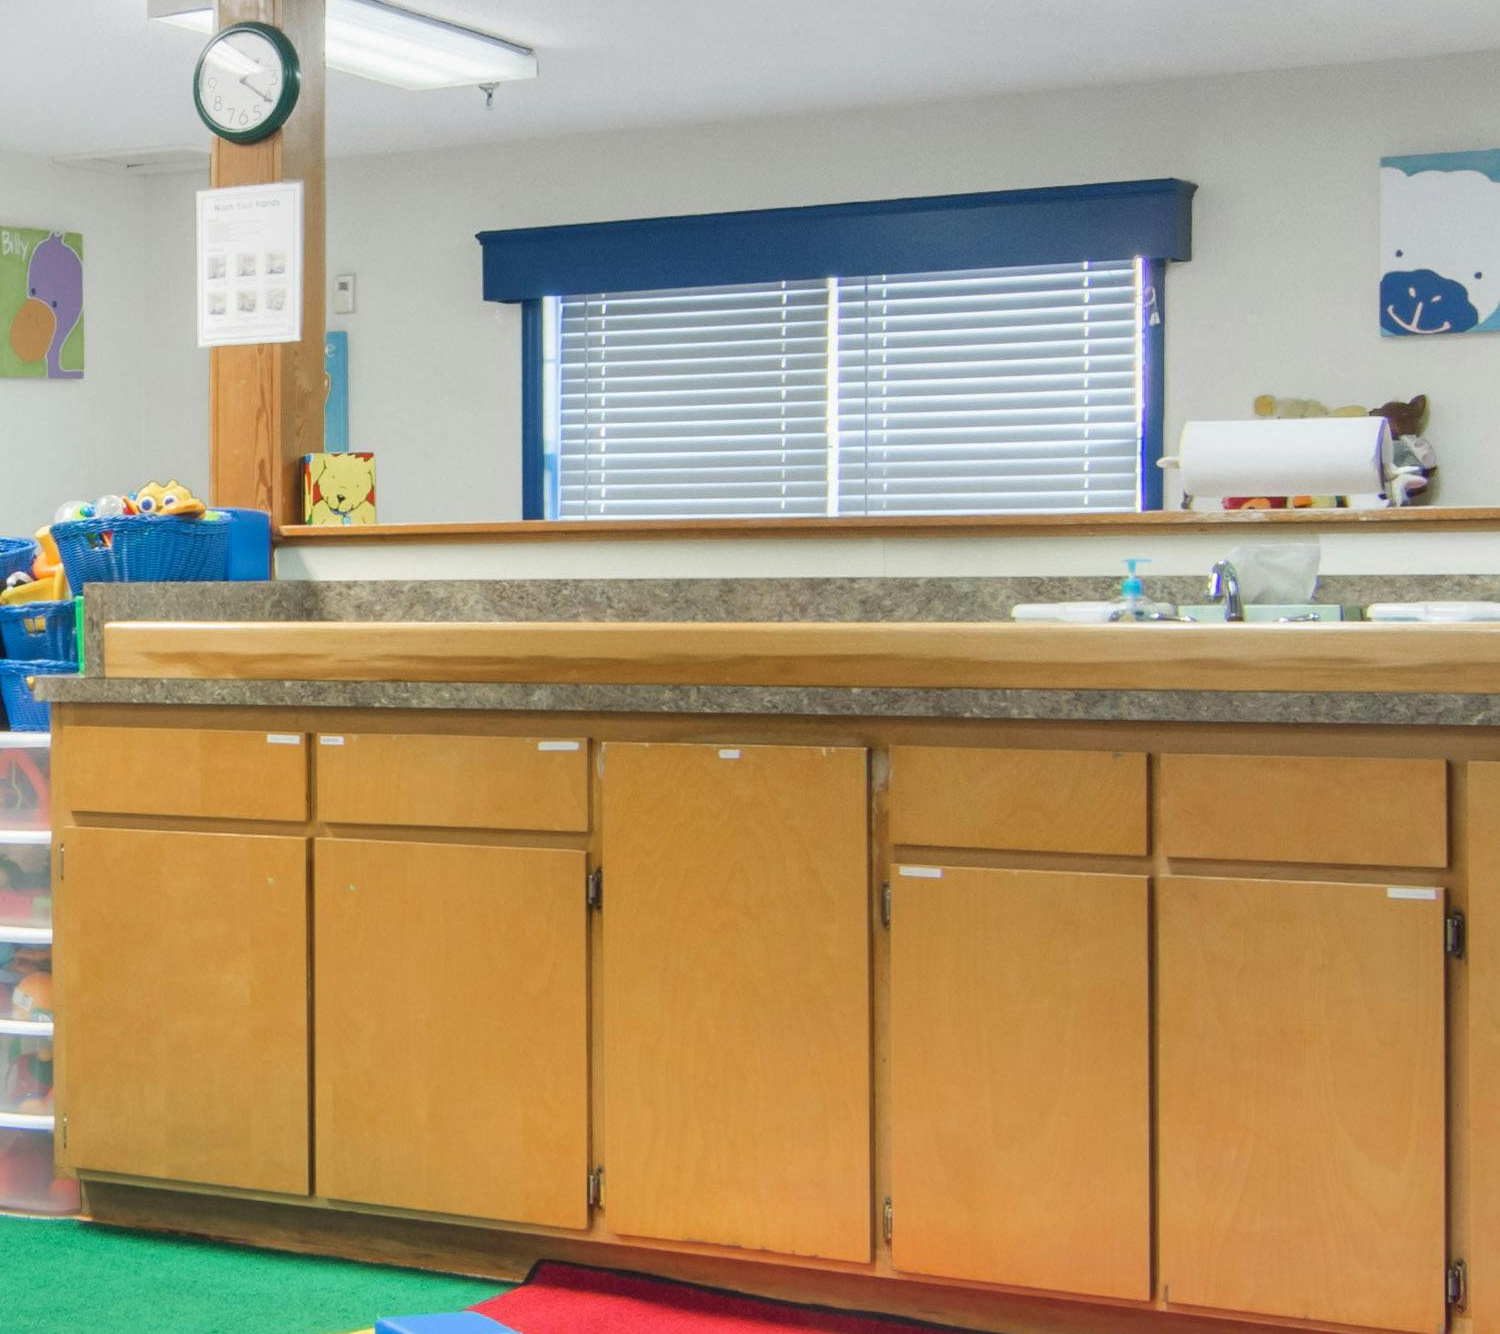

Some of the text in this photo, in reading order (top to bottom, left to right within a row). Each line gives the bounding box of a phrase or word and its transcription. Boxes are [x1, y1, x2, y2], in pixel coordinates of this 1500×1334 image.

[214, 95, 223, 112] 8
[227, 108, 236, 124] 7
[239, 110, 249, 126] 6
[253, 105, 263, 121] 5
[1, 231, 30, 262] Billy
